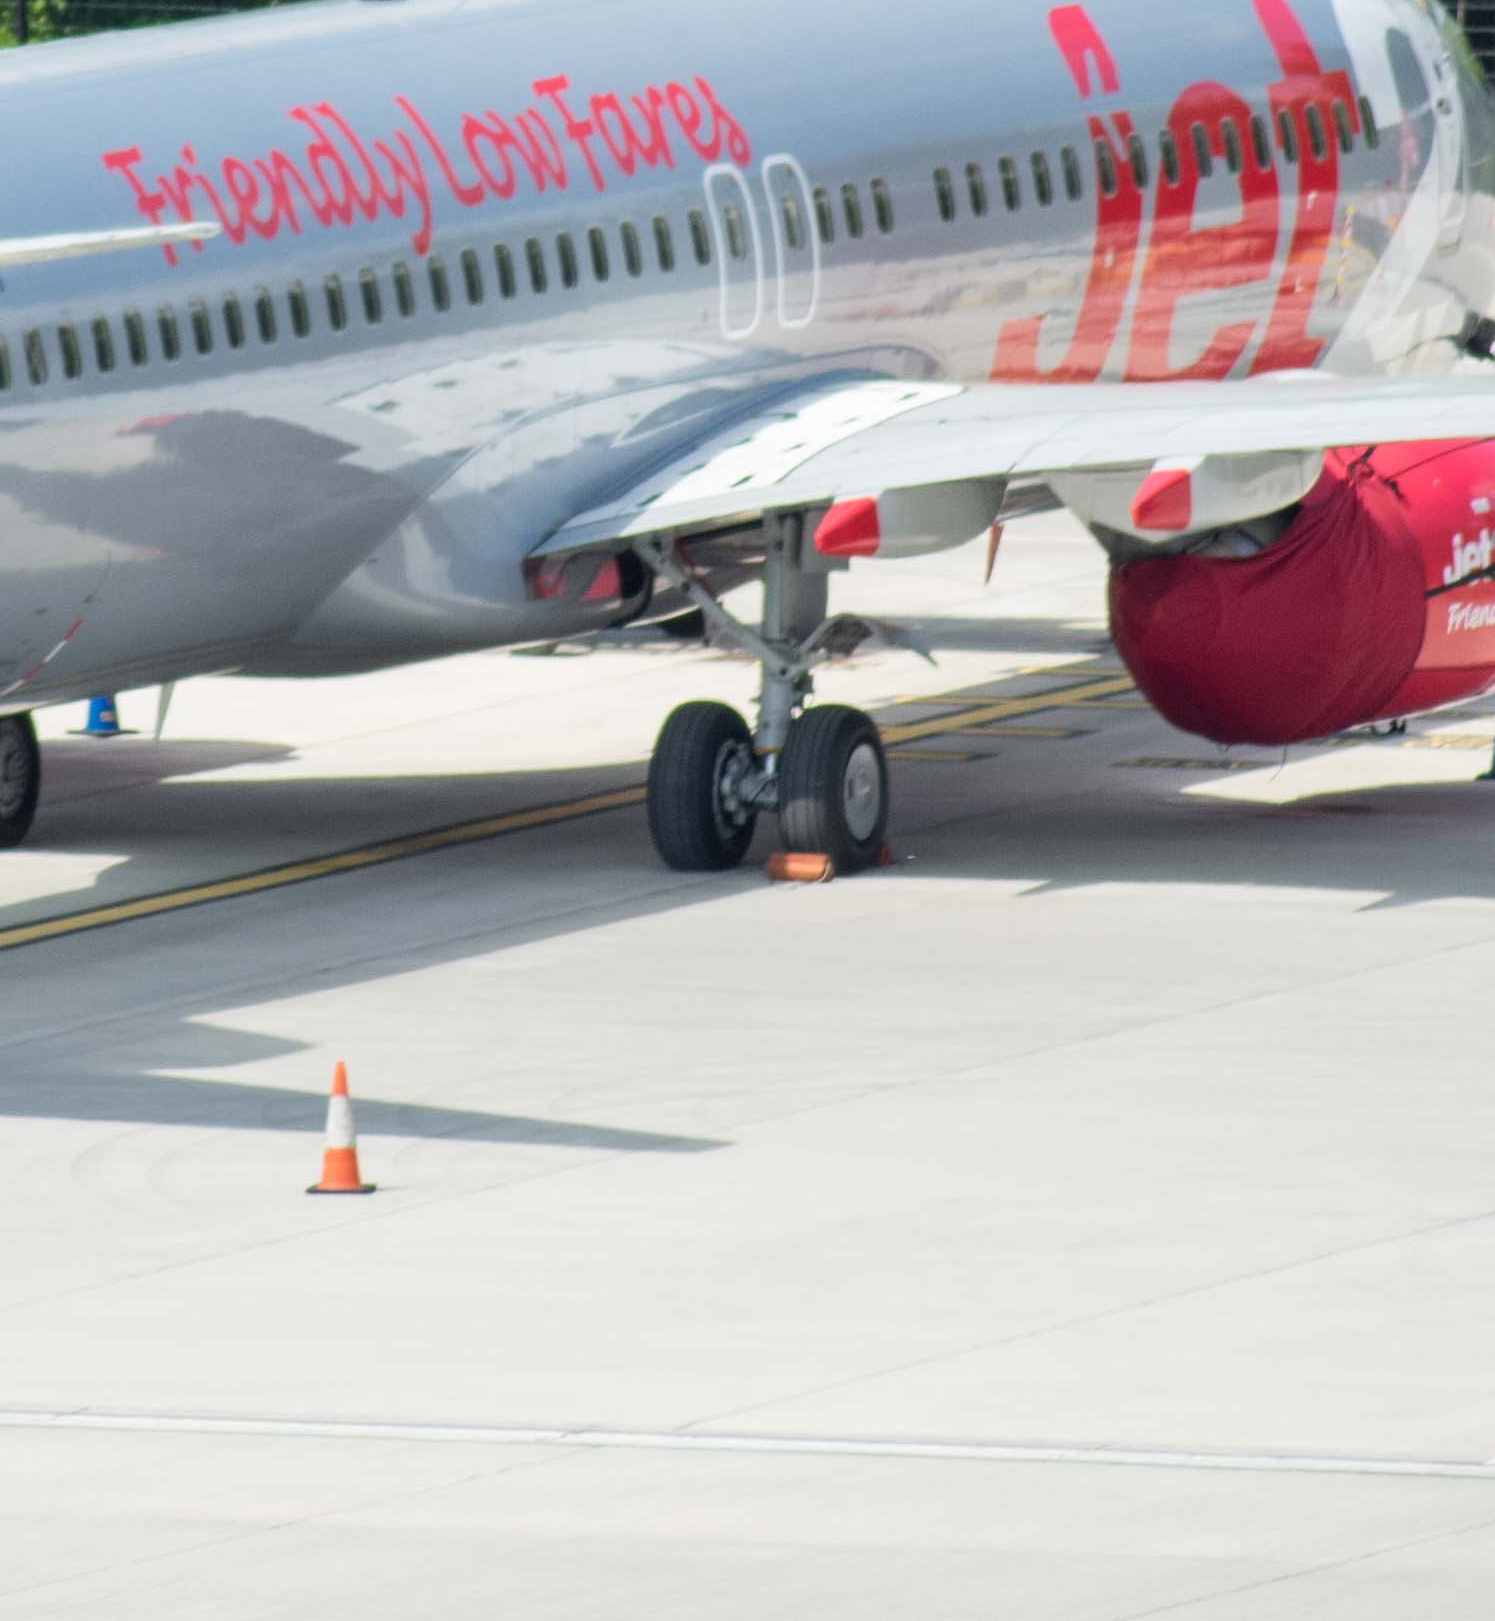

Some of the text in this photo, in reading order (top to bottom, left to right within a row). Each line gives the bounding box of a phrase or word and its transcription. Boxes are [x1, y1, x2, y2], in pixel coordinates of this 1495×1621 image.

[101, 74, 751, 267] Friendly Low Fares
